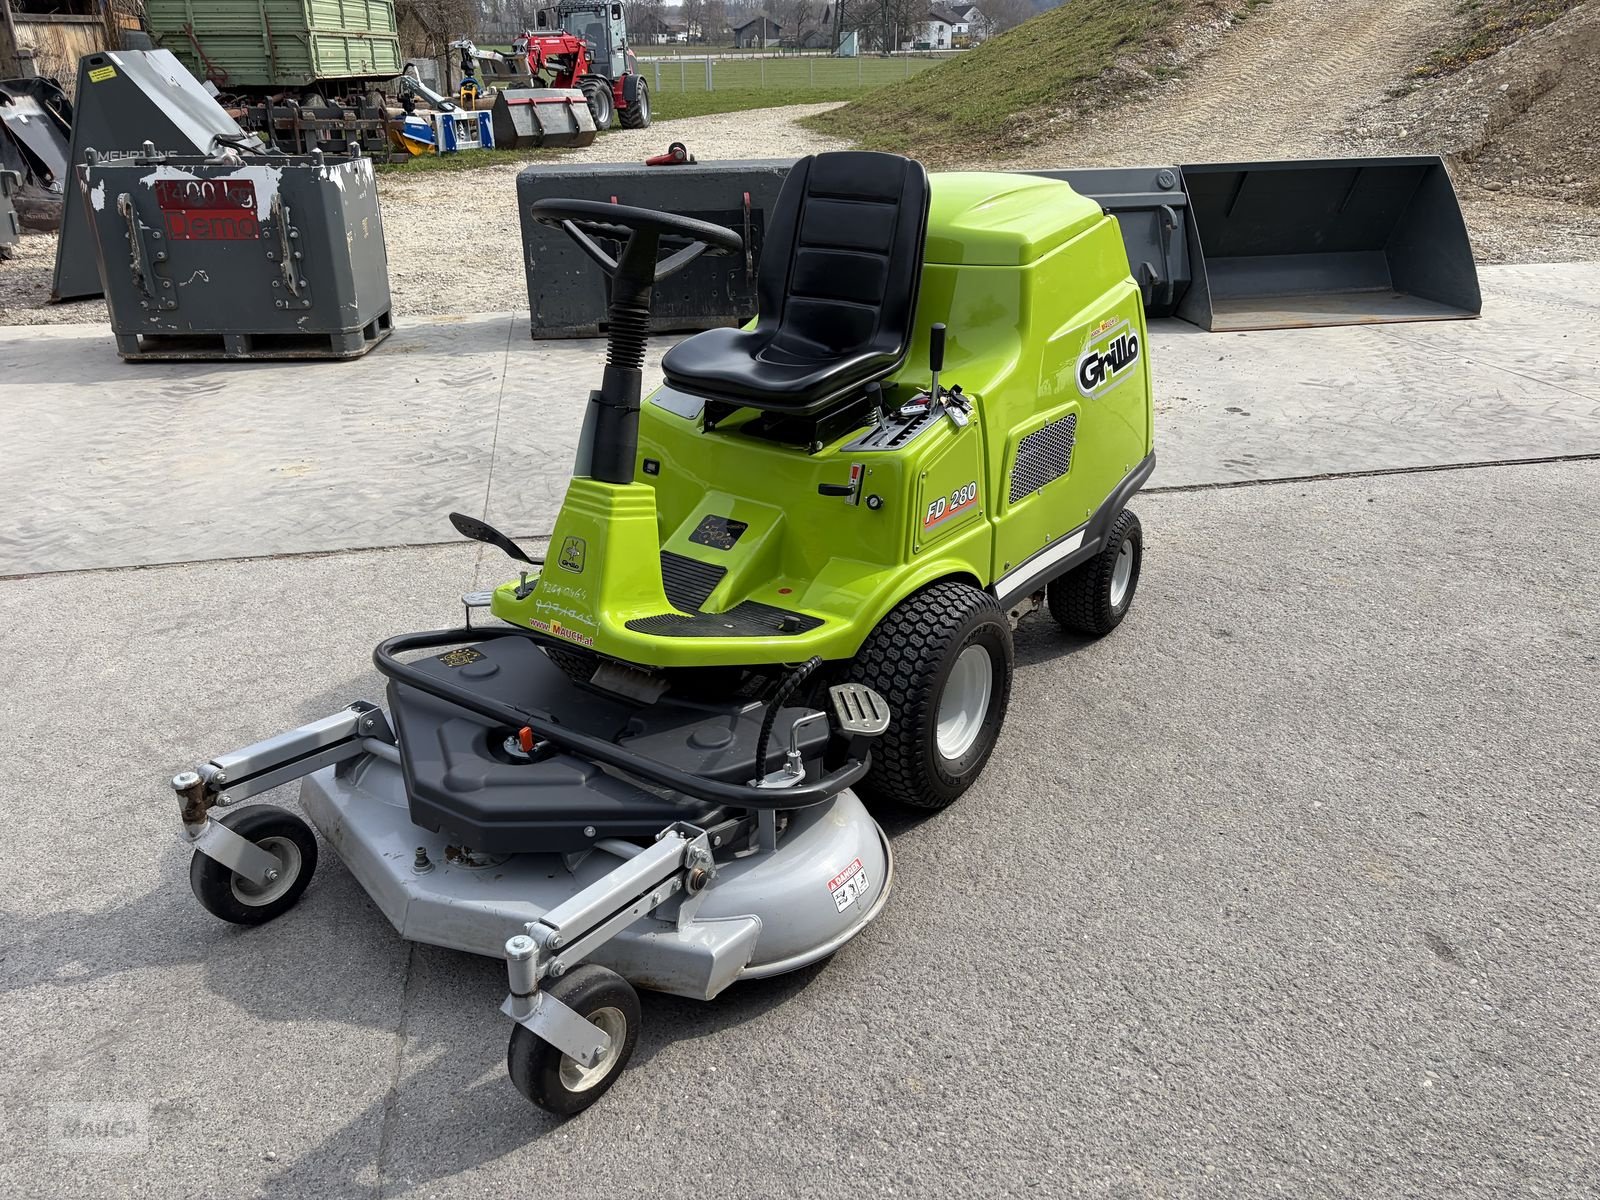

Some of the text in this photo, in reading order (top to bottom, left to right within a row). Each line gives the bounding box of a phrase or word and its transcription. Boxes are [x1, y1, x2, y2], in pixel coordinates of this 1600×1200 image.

[166, 212, 256, 240] Demo
[1079, 334, 1139, 390] Grillo
[925, 481, 976, 524] FD 280
[562, 559, 580, 570] Grillo
[835, 861, 861, 887] DANGER
